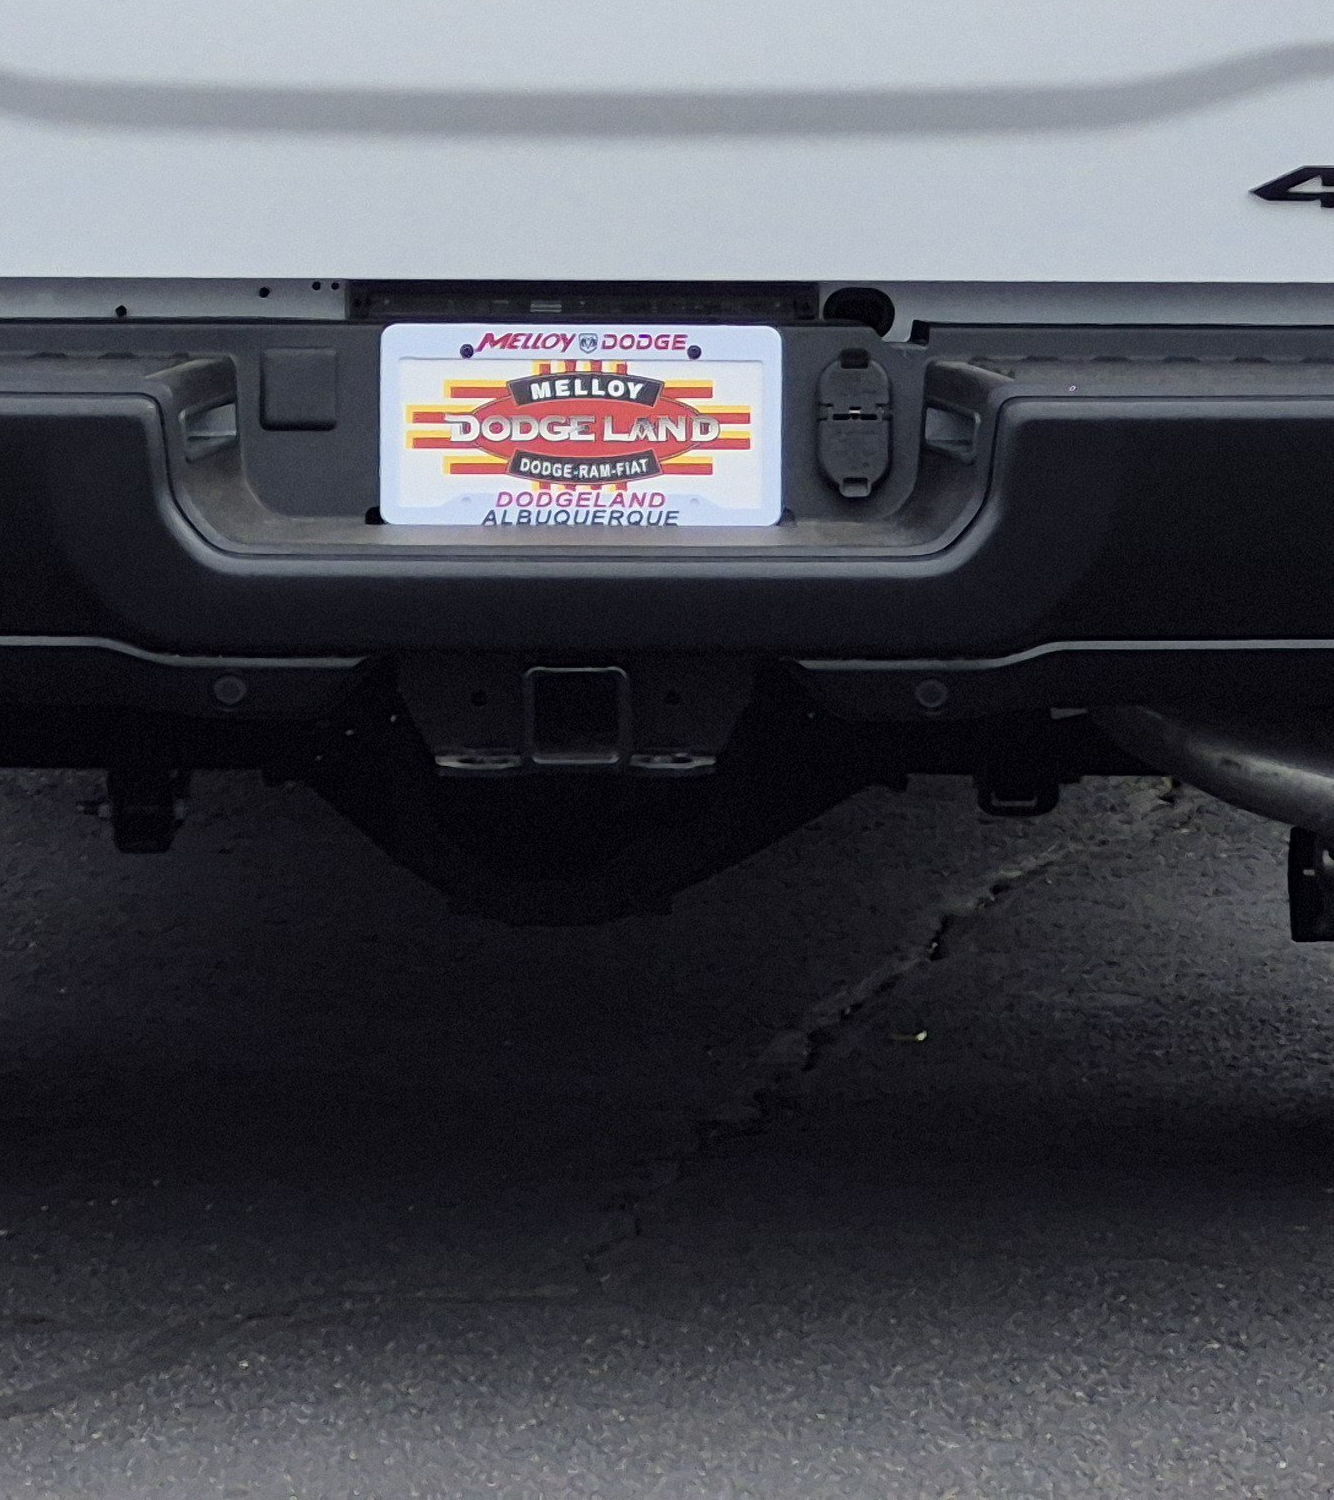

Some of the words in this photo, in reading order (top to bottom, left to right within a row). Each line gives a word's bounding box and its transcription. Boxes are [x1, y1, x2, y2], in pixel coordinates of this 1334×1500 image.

[474, 333, 576, 352] MELLOY
[600, 333, 688, 351] DODGE
[530, 377, 645, 400] MELLOY
[496, 491, 666, 507] DODGELAND
[481, 509, 680, 527] ALBUQUERQUE
